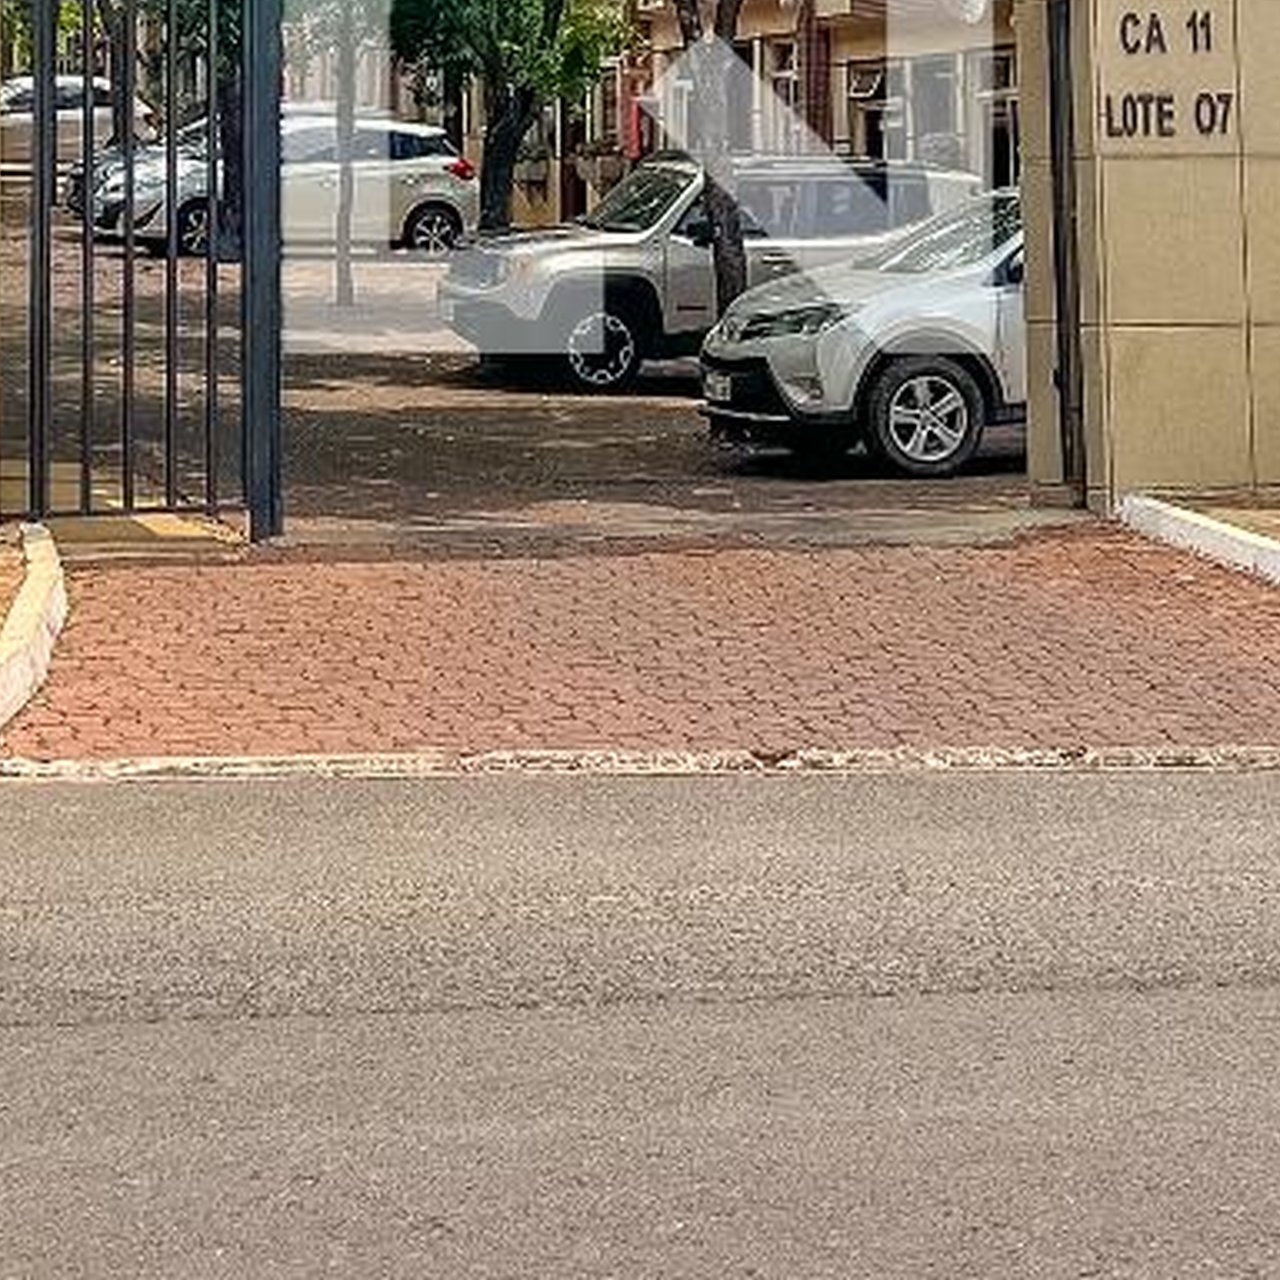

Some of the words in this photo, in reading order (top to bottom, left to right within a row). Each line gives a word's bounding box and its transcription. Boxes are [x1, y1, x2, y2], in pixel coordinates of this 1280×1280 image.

[1120, 12, 1167, 54] CA
[1186, 9, 1211, 53] 11
[1106, 93, 1175, 138] LOTE
[1195, 92, 1234, 135] 07
